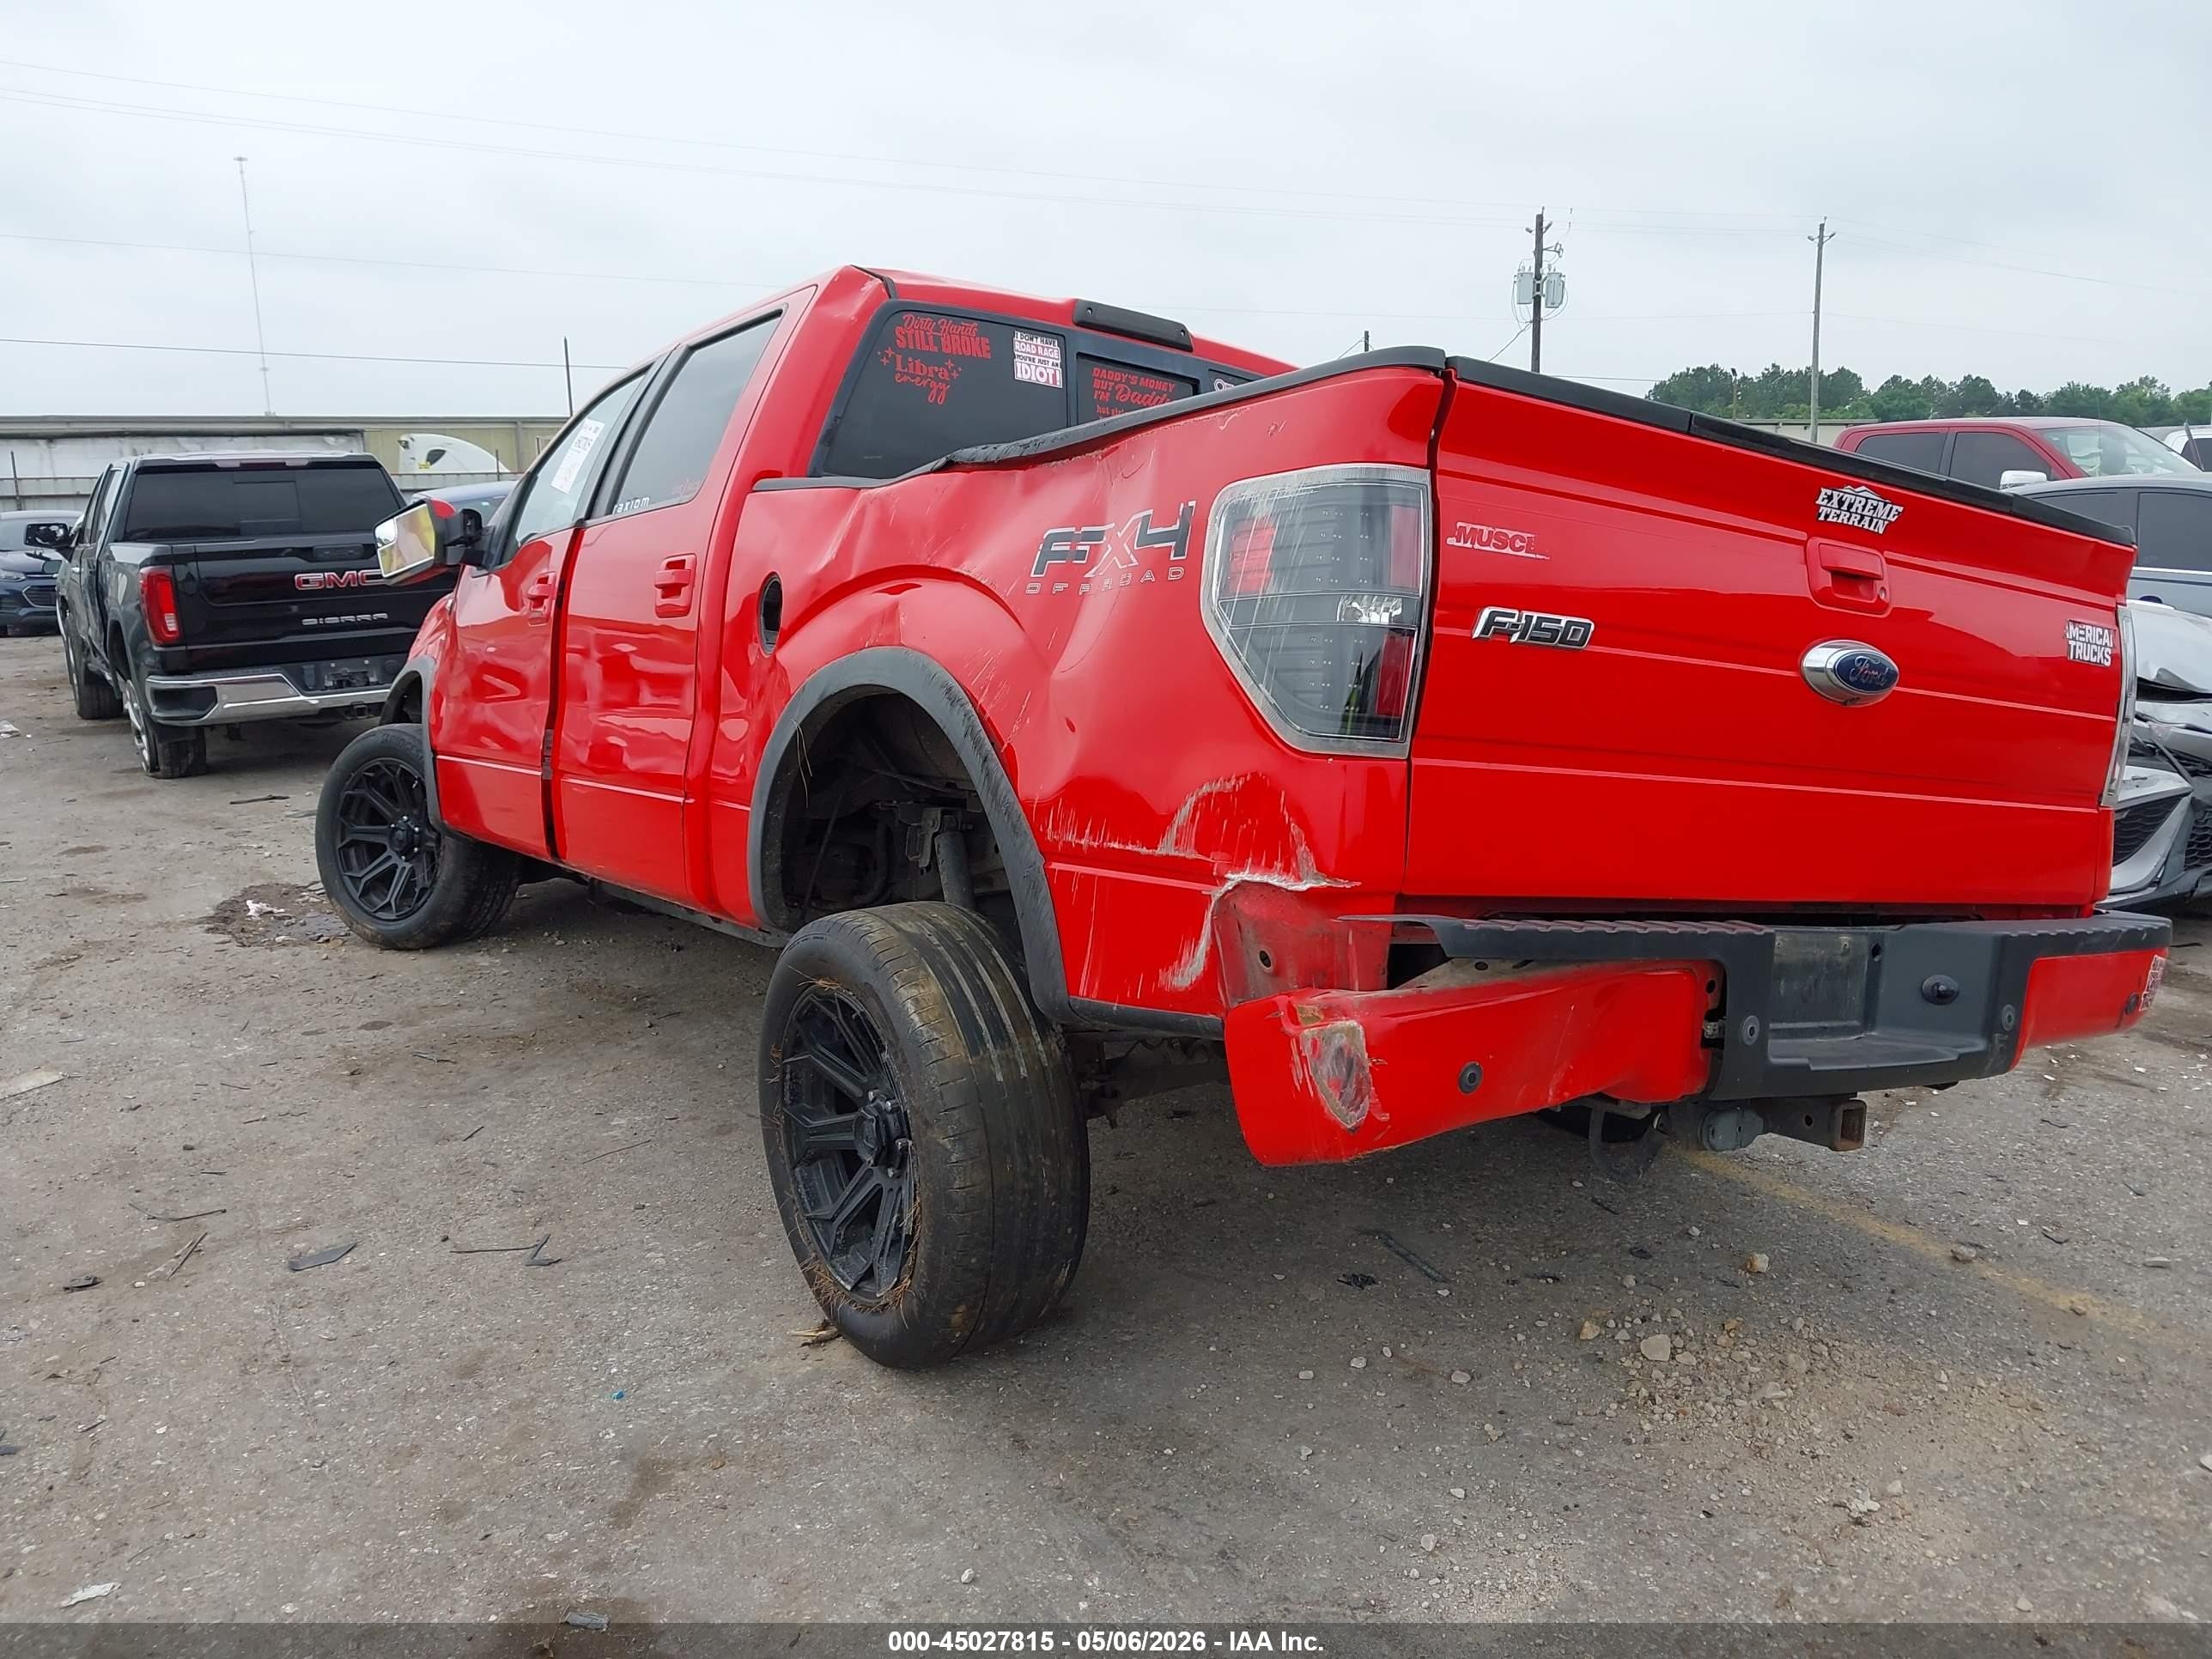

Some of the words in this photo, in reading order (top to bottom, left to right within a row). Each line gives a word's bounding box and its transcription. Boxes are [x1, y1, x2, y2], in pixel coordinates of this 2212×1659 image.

[902, 313, 936, 336] Dirty
[938, 319, 978, 337] Hands
[895, 325, 938, 352] STILL
[941, 333, 991, 359] BROKE
[1015, 341, 1036, 354] ROAD
[1037, 345, 1059, 359] RAGE
[1040, 336, 1057, 347] HAVE
[895, 354, 951, 380] Libra
[1016, 362, 1060, 386] IDIOT!
[1037, 357, 1049, 367] JUST
[895, 373, 951, 404] energy
[1092, 368, 1139, 385] DADDY'S
[1139, 377, 1176, 392] MONEY
[1093, 379, 1115, 391] BUT
[1093, 391, 1110, 402] I'M
[612, 496, 650, 514] raxiom
[1815, 488, 1905, 522] EXTREME
[1818, 506, 1889, 534] TERRAIN
[295, 569, 385, 590] GMC
[301, 612, 389, 626] SIERRA
[1472, 605, 1595, 650] F-150
[2068, 640, 2112, 666] TRUCKS
[1849, 654, 1890, 686] Ford
